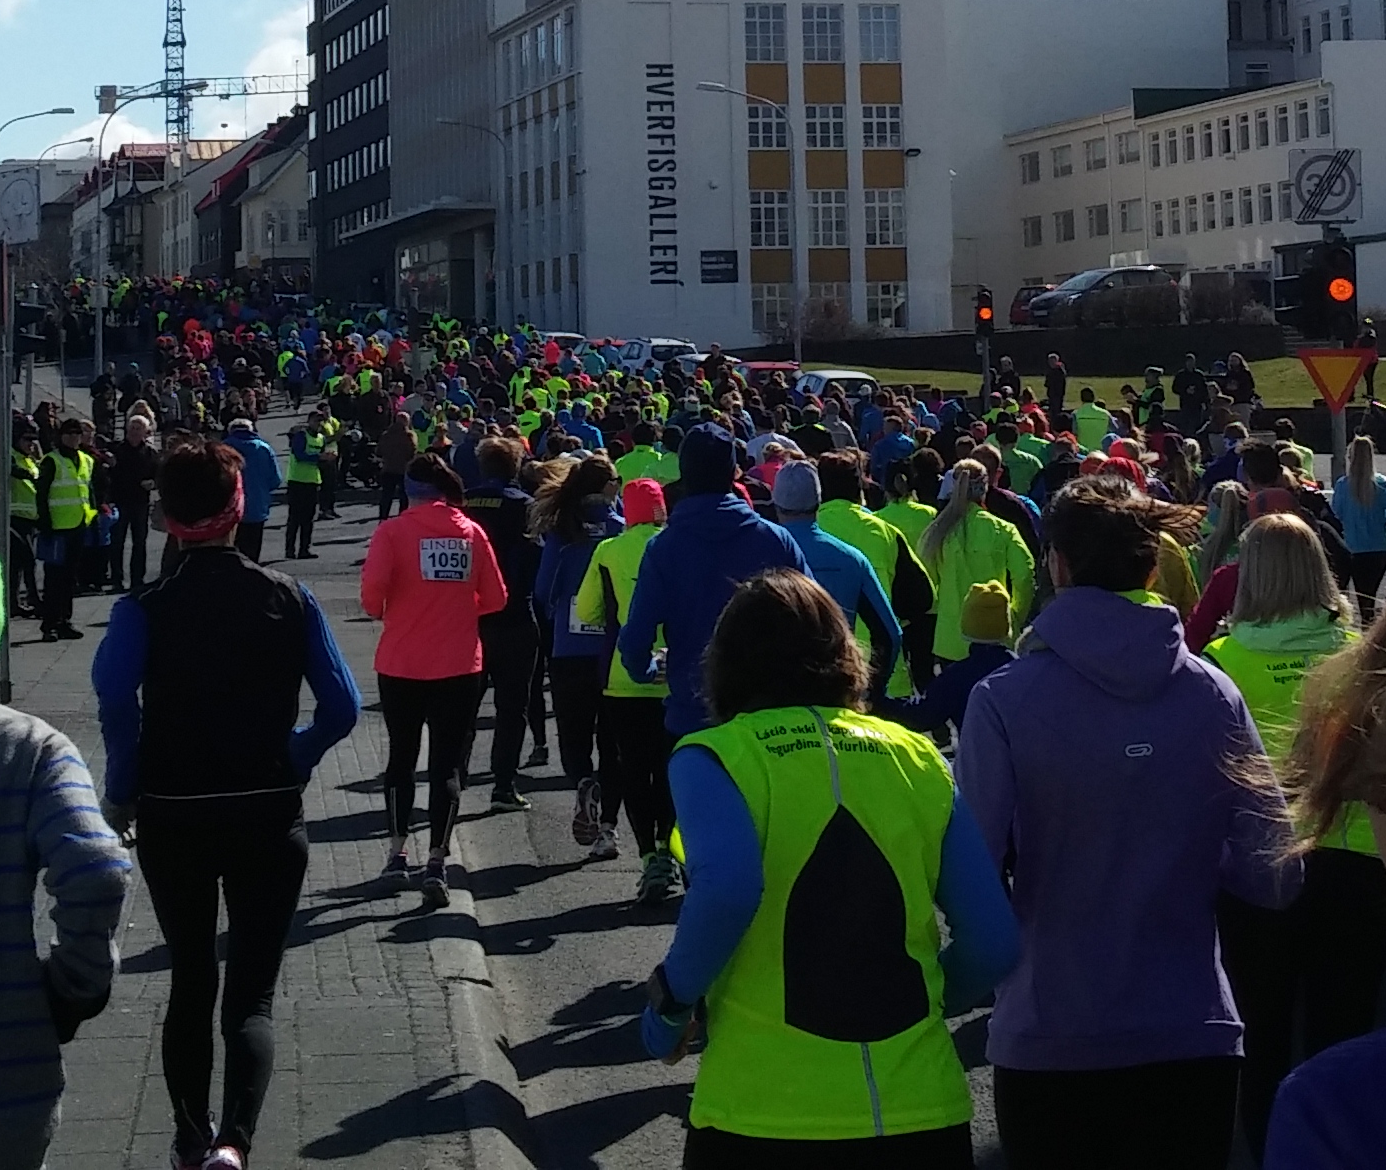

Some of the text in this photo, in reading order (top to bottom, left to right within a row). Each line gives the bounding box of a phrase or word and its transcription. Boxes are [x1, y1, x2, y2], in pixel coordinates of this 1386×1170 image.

[645, 63, 685, 287] HVERFISGALLERÍ
[1306, 173, 1347, 197] 30
[427, 551, 469, 569] 1050
[790, 722, 817, 735] ekki
